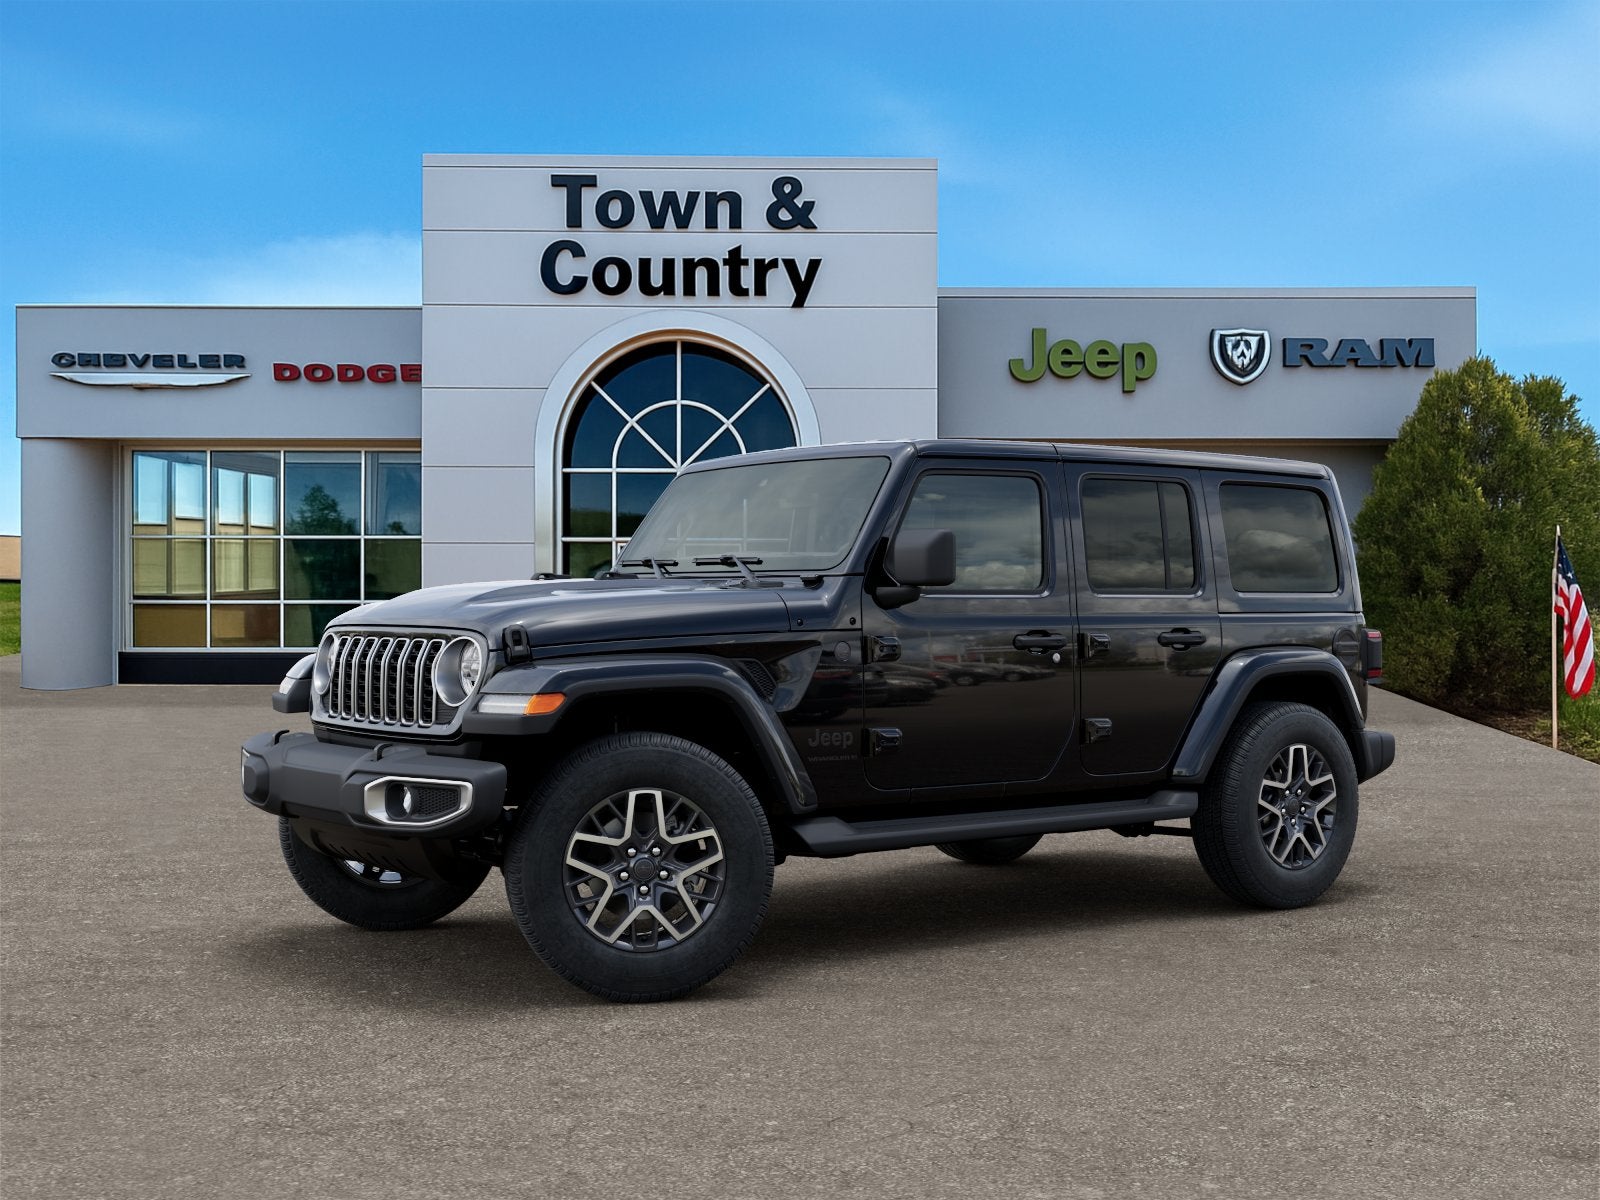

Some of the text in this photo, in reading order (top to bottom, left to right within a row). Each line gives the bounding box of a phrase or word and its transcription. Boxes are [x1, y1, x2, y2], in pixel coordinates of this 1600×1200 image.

[550, 174, 818, 229] Town &
[540, 239, 822, 308] Country
[273, 363, 422, 383] DODGE
[1008, 327, 1157, 392] Jeep
[1282, 337, 1435, 368] RAM
[808, 728, 854, 749] Jeep
